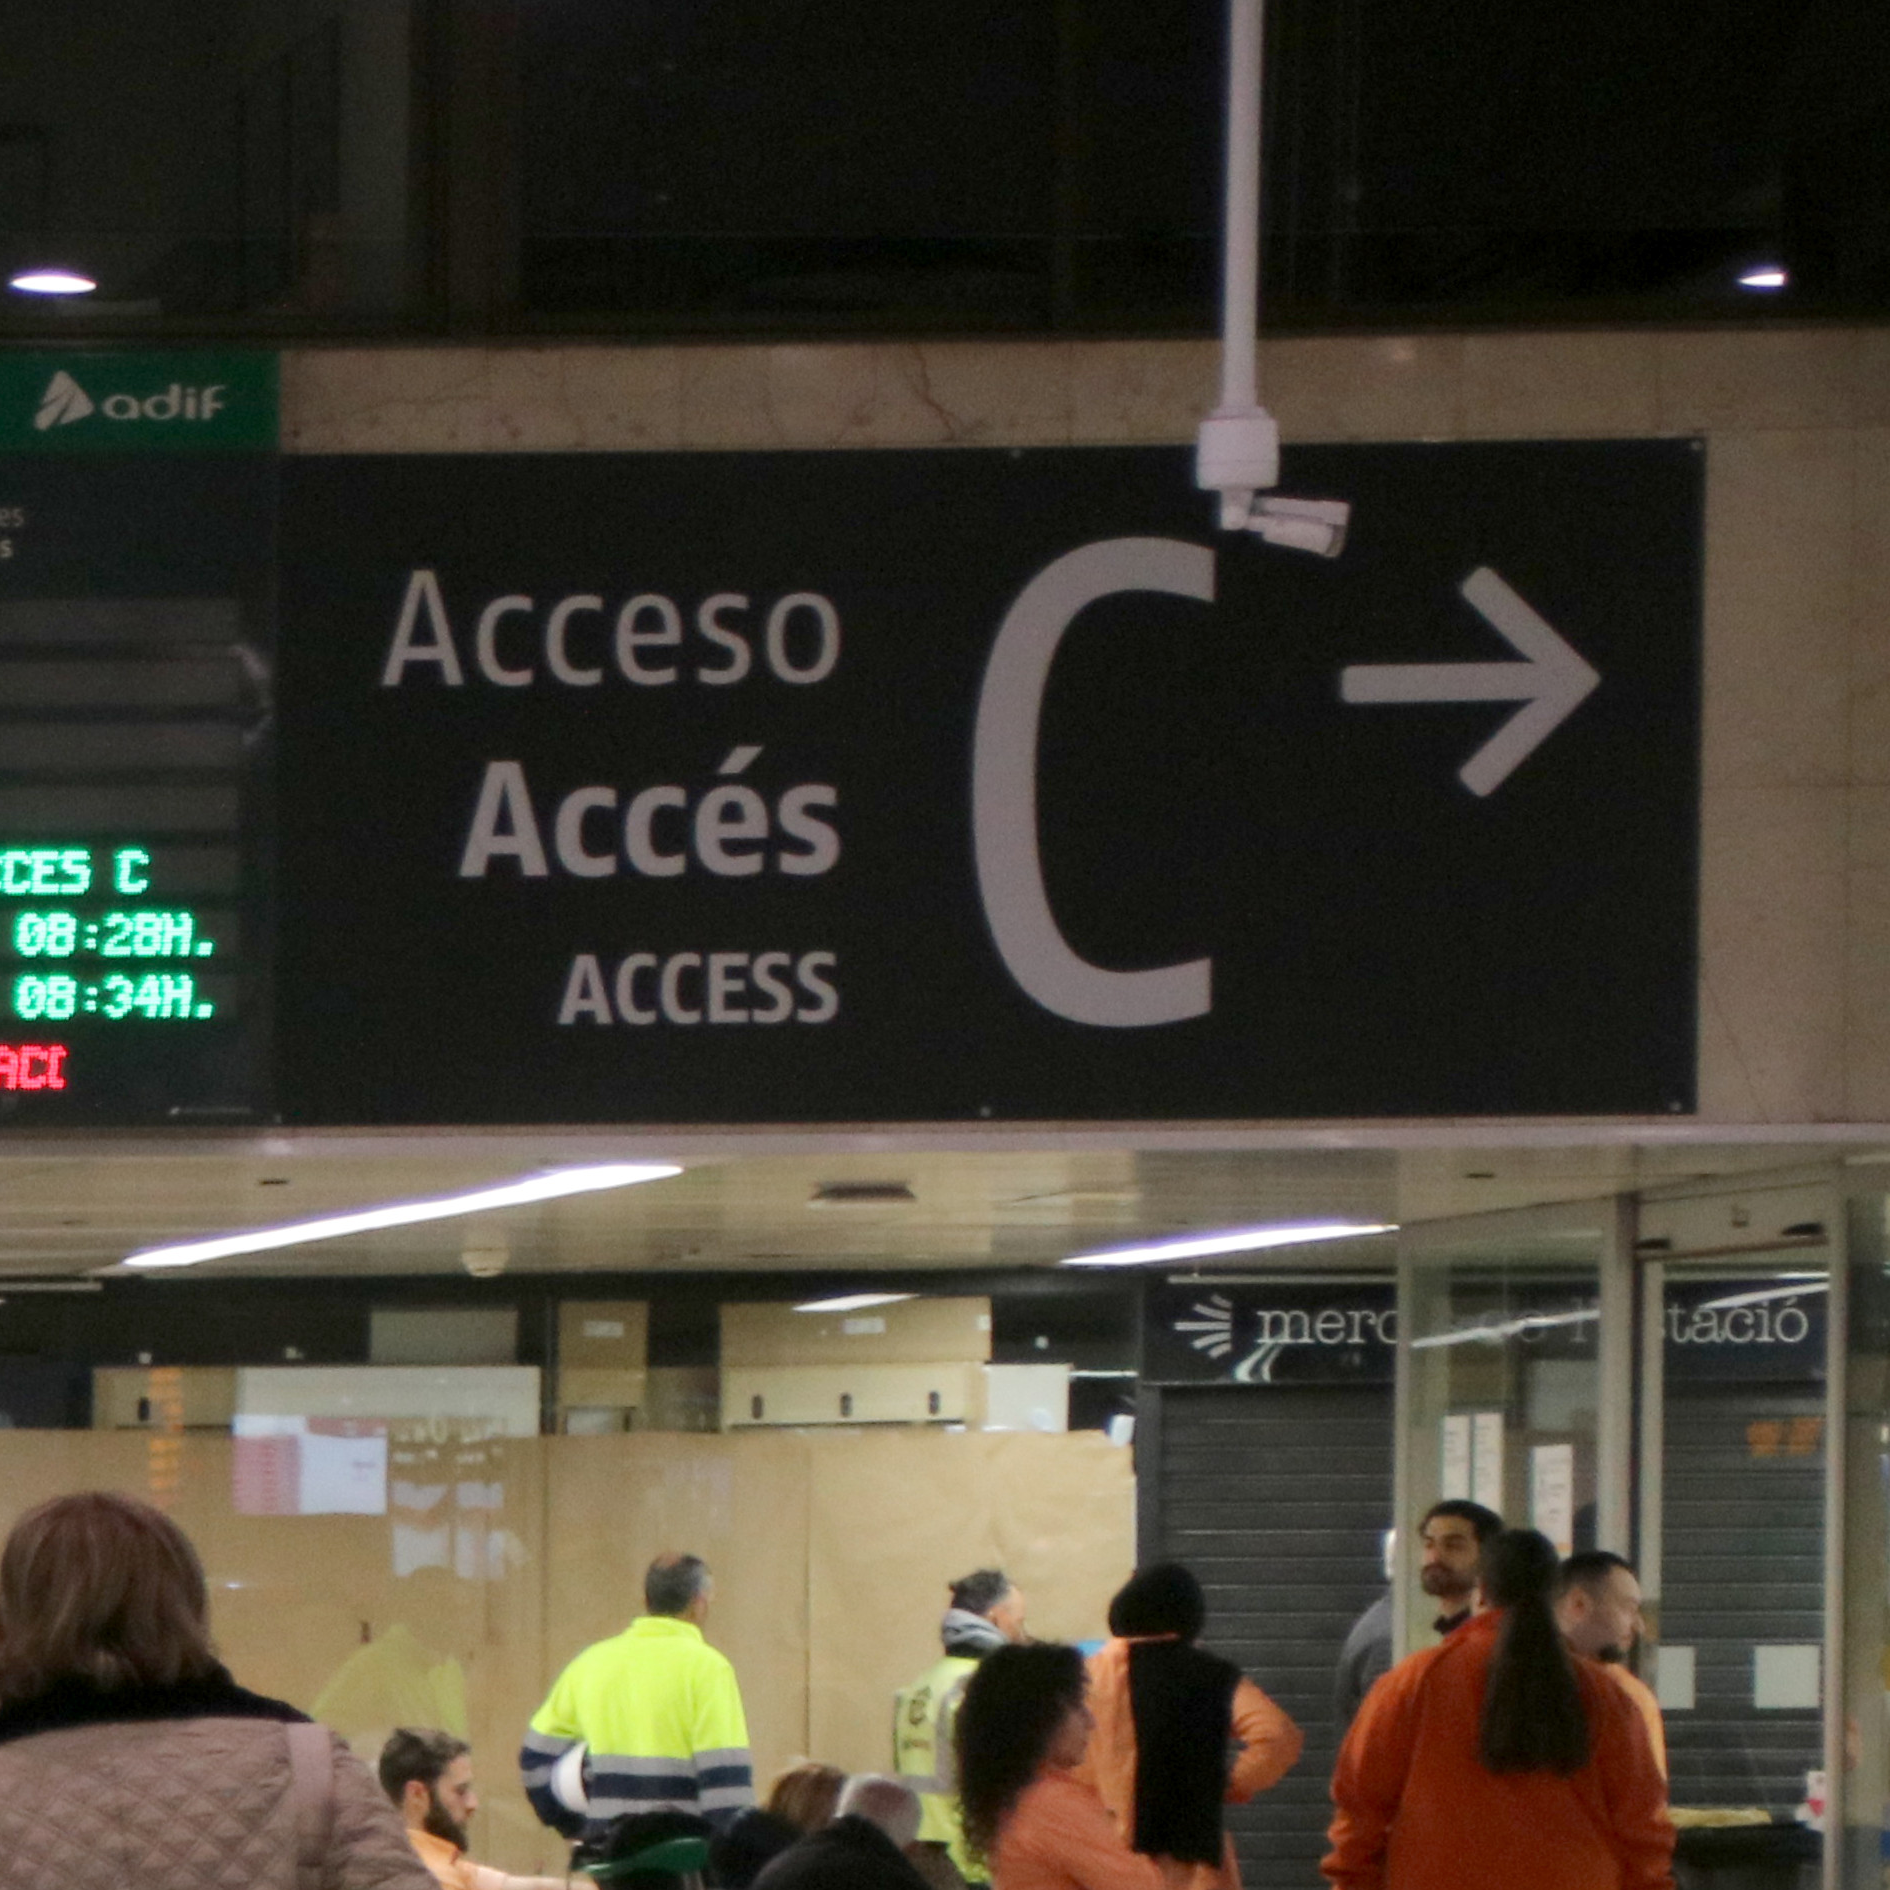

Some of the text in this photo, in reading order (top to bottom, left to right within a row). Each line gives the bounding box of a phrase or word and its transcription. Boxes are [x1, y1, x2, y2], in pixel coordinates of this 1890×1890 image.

[102, 382, 225, 421] adif
[382, 568, 842, 690] Acceso
[459, 745, 843, 879] Accés
[971, 535, 1217, 1029] C
[113, 847, 150, 899] C
[12, 910, 214, 961] 08:28H.
[12, 972, 214, 1023] 08:34H.
[557, 952, 840, 1026] ACCESS
